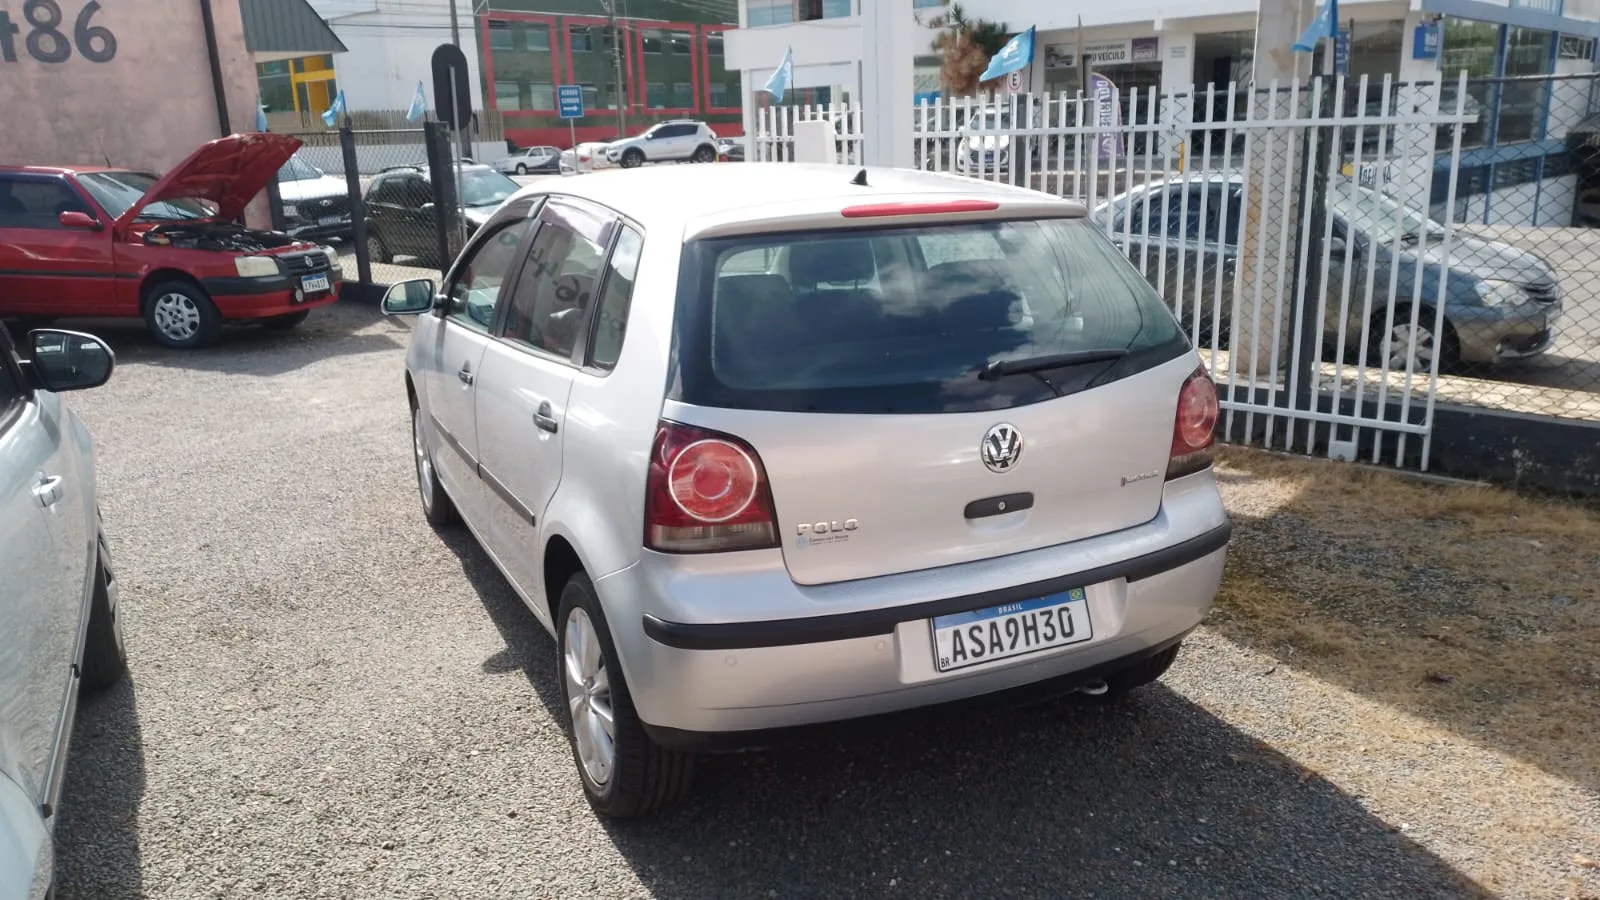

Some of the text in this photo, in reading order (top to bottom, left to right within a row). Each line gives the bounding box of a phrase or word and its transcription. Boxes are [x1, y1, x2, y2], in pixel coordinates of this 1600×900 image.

[796, 518, 859, 536] POLO
[998, 604, 1022, 614] BRASIL
[952, 606, 1075, 662] ASA9H30
[940, 656, 950, 668] BR
